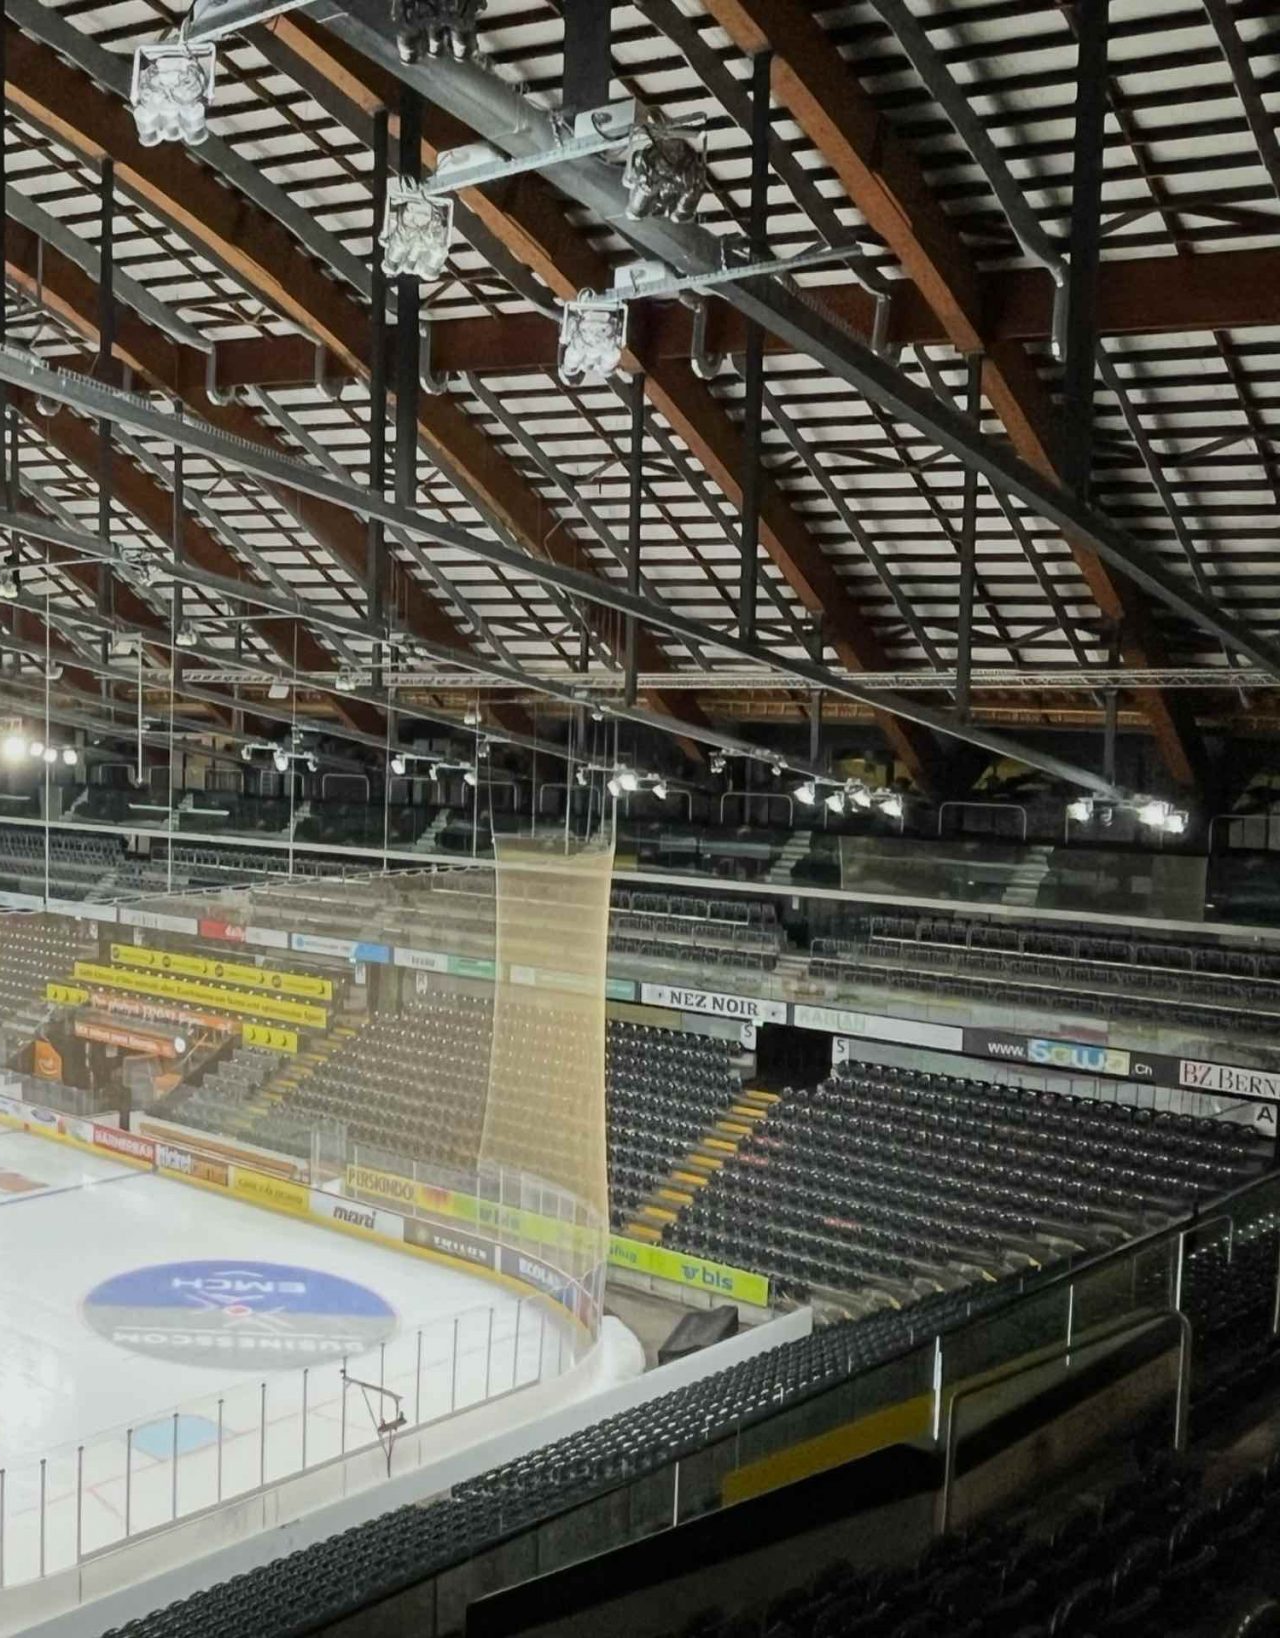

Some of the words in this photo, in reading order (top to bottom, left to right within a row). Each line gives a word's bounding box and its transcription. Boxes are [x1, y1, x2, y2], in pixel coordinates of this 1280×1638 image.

[670, 989, 706, 1009] NEZ
[712, 994, 759, 1017] NOIR
[743, 1025, 753, 1038] S
[837, 1039, 846, 1053] S
[1183, 1062, 1212, 1086] BZ
[1256, 1106, 1274, 1124] A
[333, 1205, 376, 1229] marti
[172, 1277, 306, 1293] EMCH
[703, 1267, 733, 1291] bls
[113, 1331, 364, 1352] BUSINESSCOM
